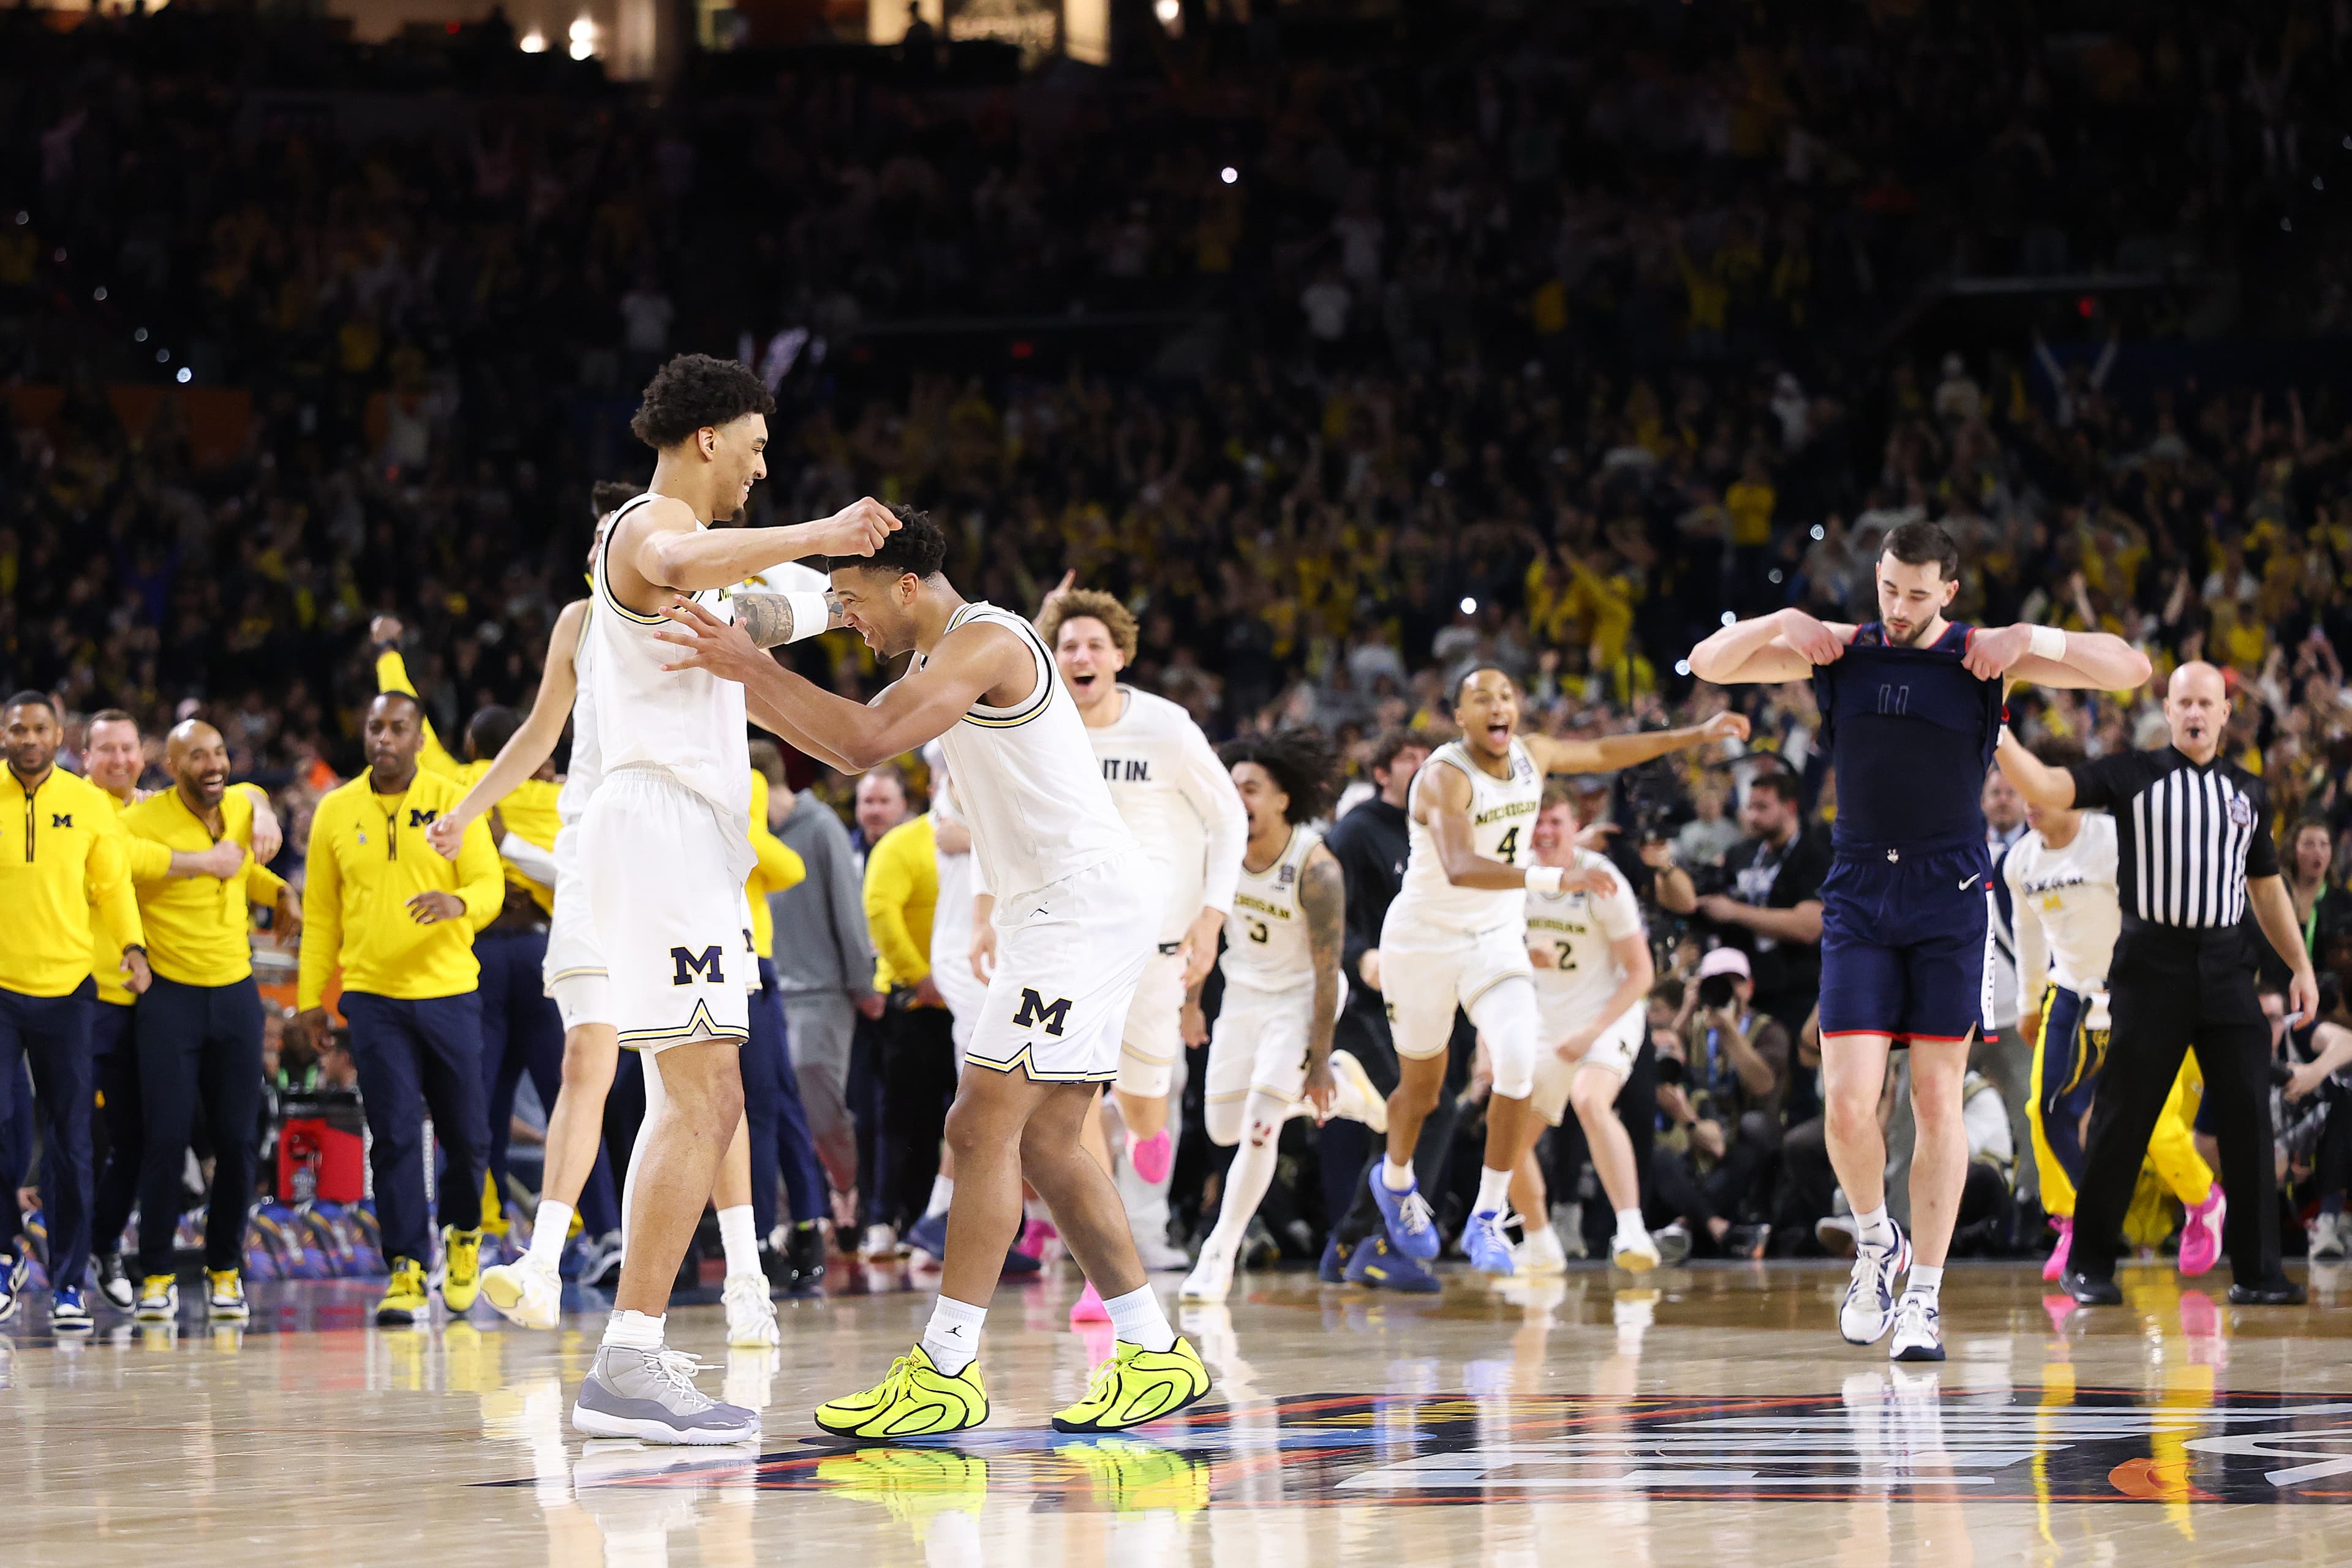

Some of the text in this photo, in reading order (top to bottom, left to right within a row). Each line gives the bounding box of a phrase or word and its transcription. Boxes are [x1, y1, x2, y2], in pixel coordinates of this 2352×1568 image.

[1126, 760, 1152, 780] IN.
[53, 813, 72, 827] M
[409, 809, 439, 827] M
[1496, 826, 1520, 864] 4
[671, 945, 725, 986] M
[1555, 941, 1577, 970] 2
[1012, 987, 1072, 1037] M
